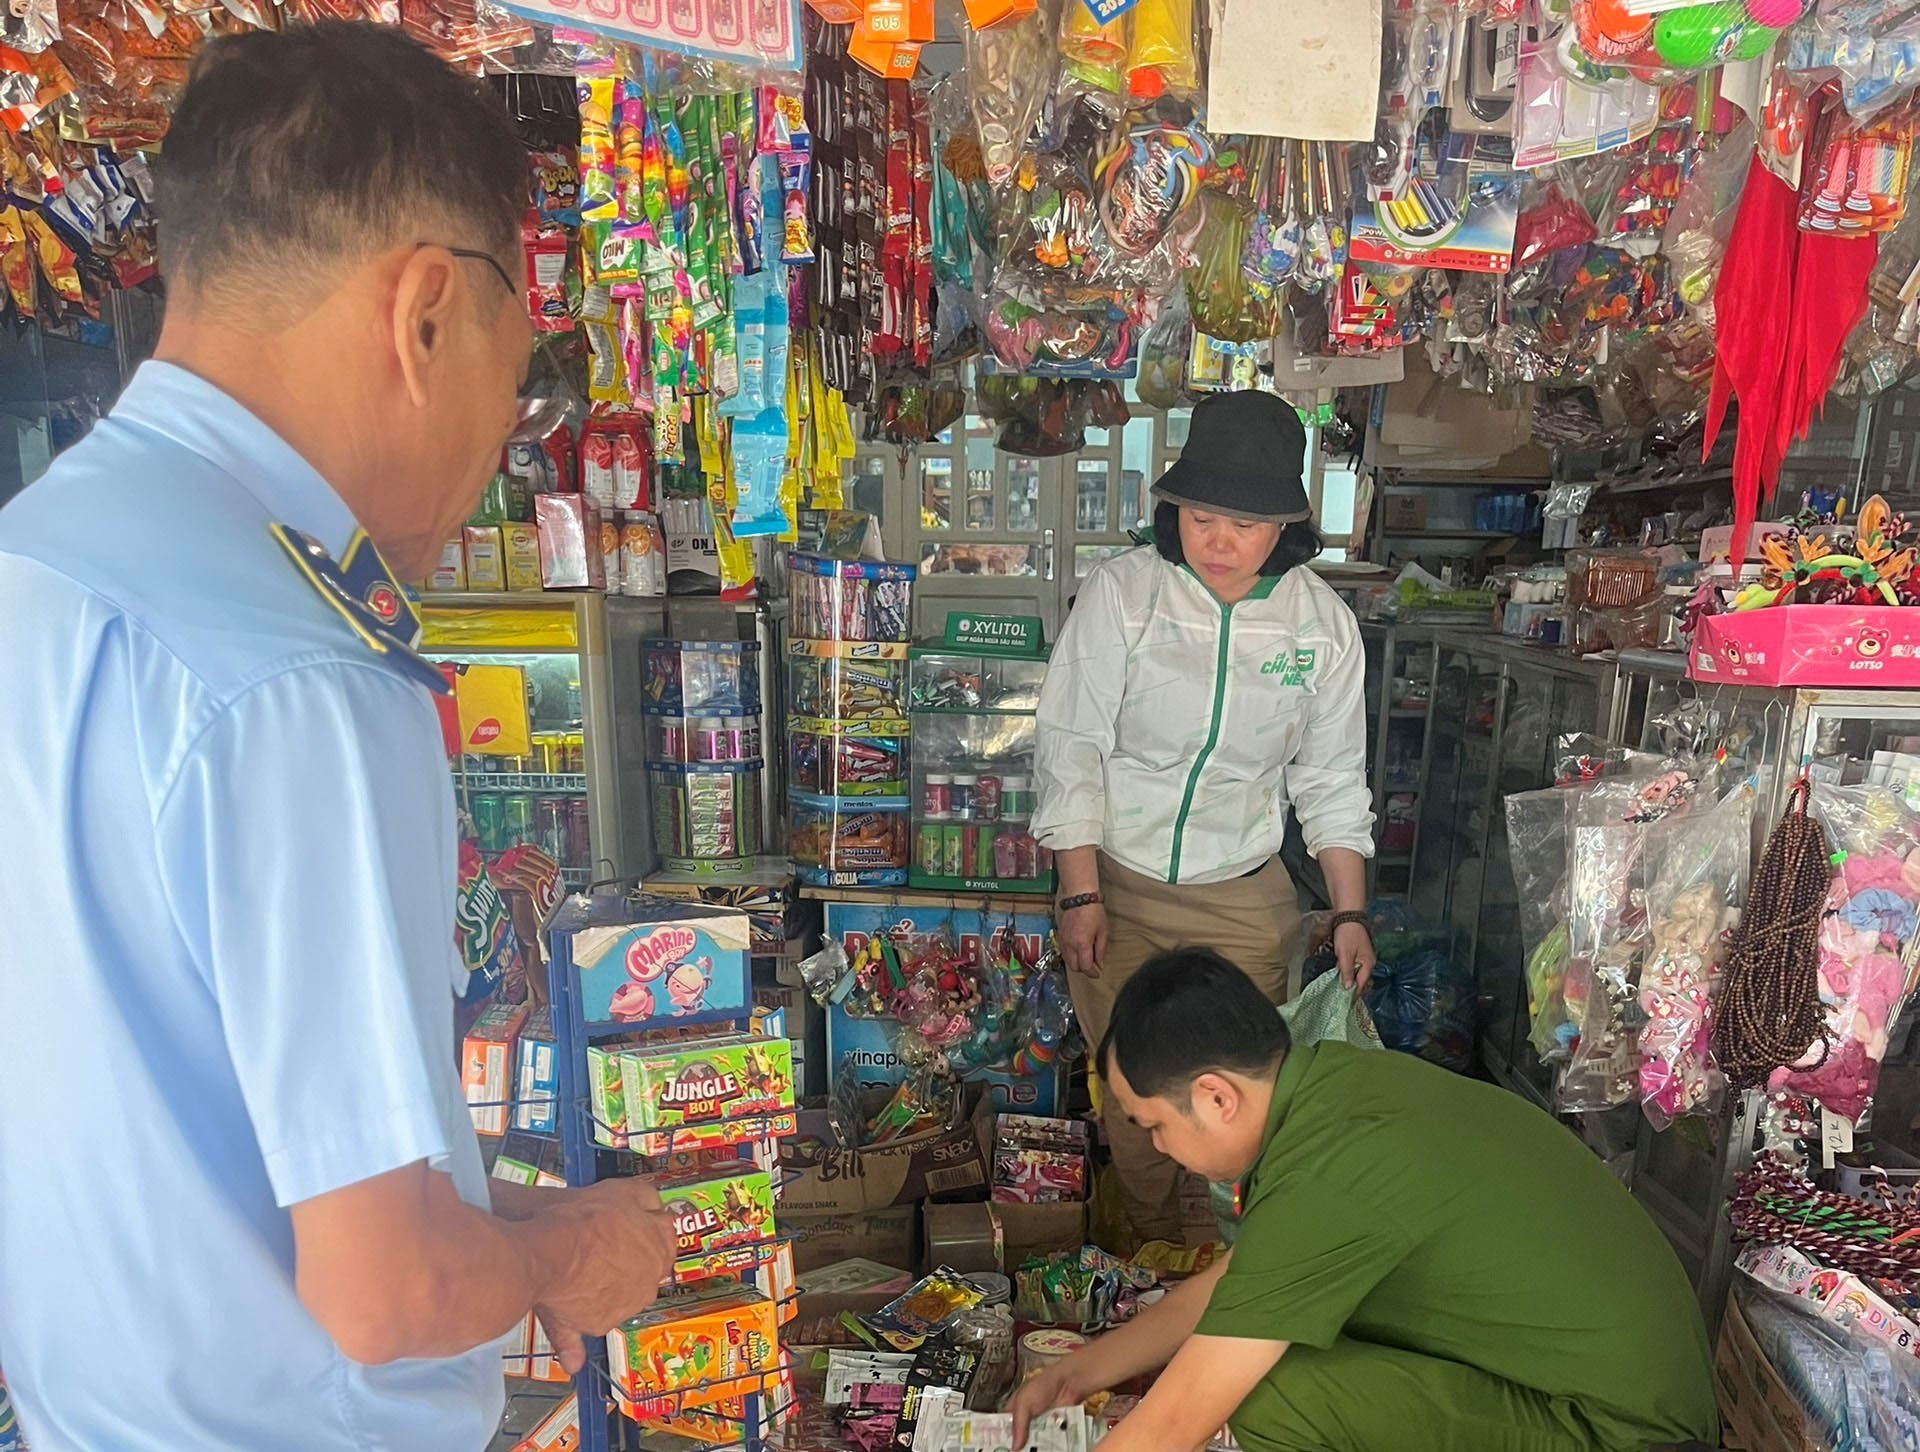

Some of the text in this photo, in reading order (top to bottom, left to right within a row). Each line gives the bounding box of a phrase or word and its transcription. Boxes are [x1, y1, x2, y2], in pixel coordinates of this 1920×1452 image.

[871, 15, 900, 31] 505
[893, 53, 913, 68] 505
[692, 538, 708, 550] ON
[973, 620, 1027, 637] XYLITOL
[1850, 660, 1884, 671] LOTSO
[843, 800, 874, 809] mentos
[835, 871, 858, 886] GOLIA
[972, 880, 999, 890] XYLITOL
[661, 1073, 737, 1102] JUNGLE
[689, 1100, 715, 1115] BOY
[775, 1115, 791, 1131] 3D
[676, 1235, 696, 1248] OY
[1869, 1309, 1899, 1337] DIY
